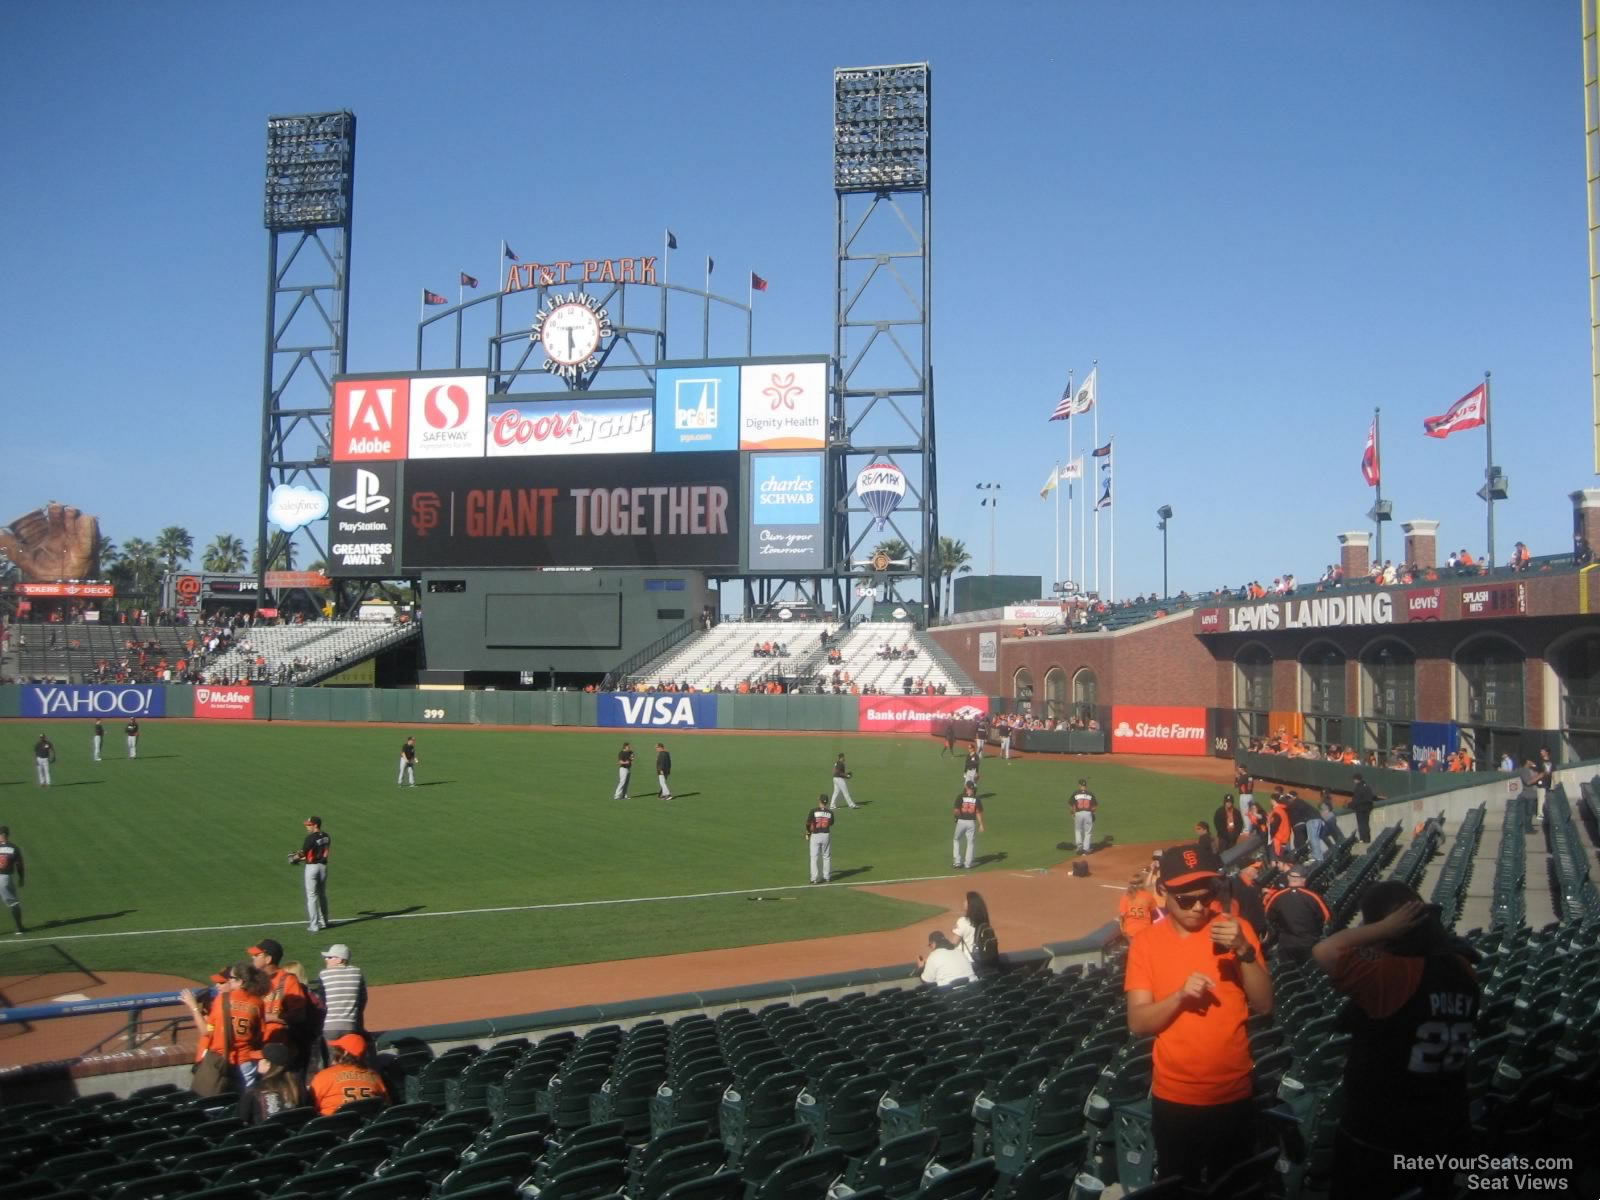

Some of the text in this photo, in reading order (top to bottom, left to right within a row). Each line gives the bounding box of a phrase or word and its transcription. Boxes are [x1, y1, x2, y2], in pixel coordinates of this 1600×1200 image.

[505, 256, 658, 293] AT&T PARK
[529, 291, 612, 341] SAN FRANCISCO
[542, 356, 598, 377] GIANTS
[677, 408, 716, 428] PG&E
[746, 417, 819, 430] Dignity Health
[491, 408, 579, 447] Coors
[422, 431, 469, 442] SAFEWAY
[348, 436, 391, 454] Adobe
[760, 475, 814, 492] charles
[861, 472, 900, 486] RE/MAX
[279, 500, 319, 512] salesforce
[760, 493, 814, 504] SCHWAB
[465, 487, 559, 537] GIANT
[570, 486, 729, 536] TOGETHER
[339, 521, 386, 533] PlayStation
[760, 530, 813, 546] Own your
[332, 543, 392, 555] GREATNESS
[84, 587, 111, 595] DECK
[1463, 591, 1489, 603] SPLASH
[1285, 592, 1393, 629] LANDING
[34, 688, 152, 714] YAHOO!
[210, 692, 250, 703] McAfee
[424, 709, 444, 718] 399
[614, 696, 694, 725] VISA
[867, 709, 895, 720] Bank
[896, 709, 907, 720] of
[1135, 722, 1205, 739] State Farm
[1214, 737, 1228, 751] 365
[1130, 907, 1145, 917] 55
[1429, 992, 1473, 1017] POSEY
